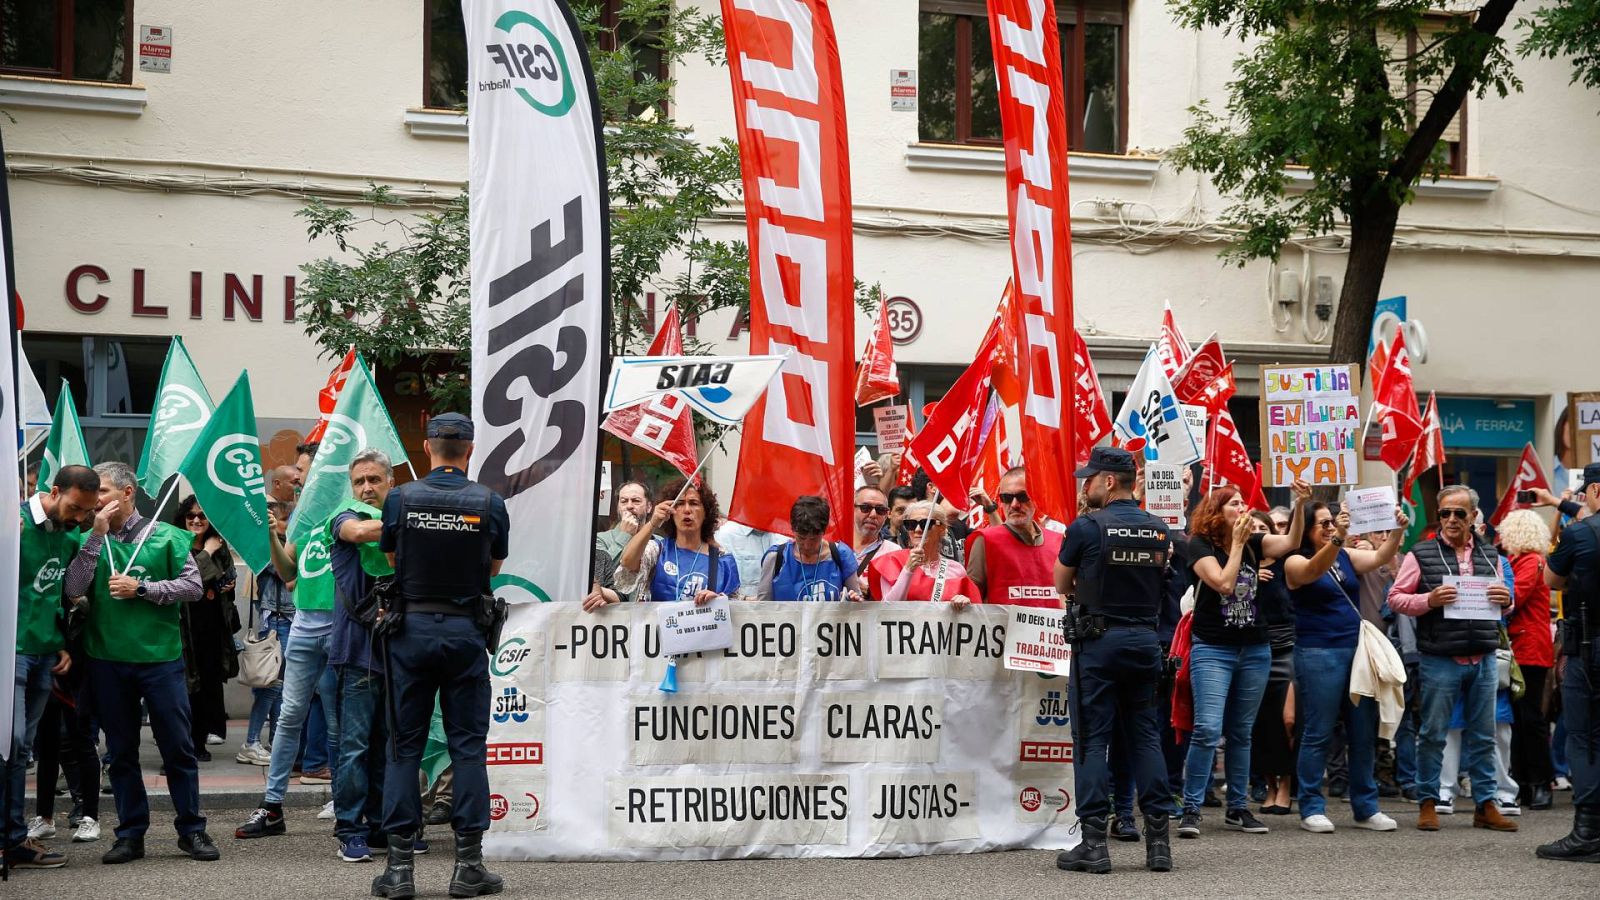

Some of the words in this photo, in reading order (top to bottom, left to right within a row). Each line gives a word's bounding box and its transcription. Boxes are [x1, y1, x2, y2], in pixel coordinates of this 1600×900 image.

[888, 309, 914, 333] 35
[1267, 368, 1349, 393] JUSTICIA
[1270, 405, 1302, 426] EN
[1307, 401, 1358, 422] LUCHA
[1475, 419, 1524, 432] FERRAZ
[1152, 471, 1160, 479] NO
[1162, 471, 1174, 480] DEIS
[1147, 481, 1155, 490] LA
[1156, 481, 1181, 490] ESPALDA
[243, 500, 263, 526] Madrid
[407, 512, 465, 523] POLICIA
[406, 520, 480, 532] NACIONAL
[1107, 528, 1158, 539] POLICIA
[1112, 550, 1153, 563] U.I.P.
[1024, 589, 1051, 597] CCOO
[1016, 612, 1027, 623] NO
[1028, 614, 1045, 626] DEIS
[1046, 618, 1056, 628] LA
[555, 624, 629, 659] -POR
[817, 622, 861, 657] SIN
[881, 621, 1005, 658] TRAMPAS
[1039, 631, 1045, 642] A
[1048, 632, 1064, 646] LOS
[498, 648, 531, 663] CSIF
[496, 694, 526, 712] STAJ
[1040, 699, 1068, 716] STAJ
[634, 704, 795, 741] FUNCIONES
[827, 703, 941, 740] CLARAS-
[1024, 745, 1073, 759] CCOO
[615, 785, 847, 823] -RETRIBUCIONES
[873, 783, 970, 820] JUSTAS-
[1023, 790, 1039, 801] UGT
